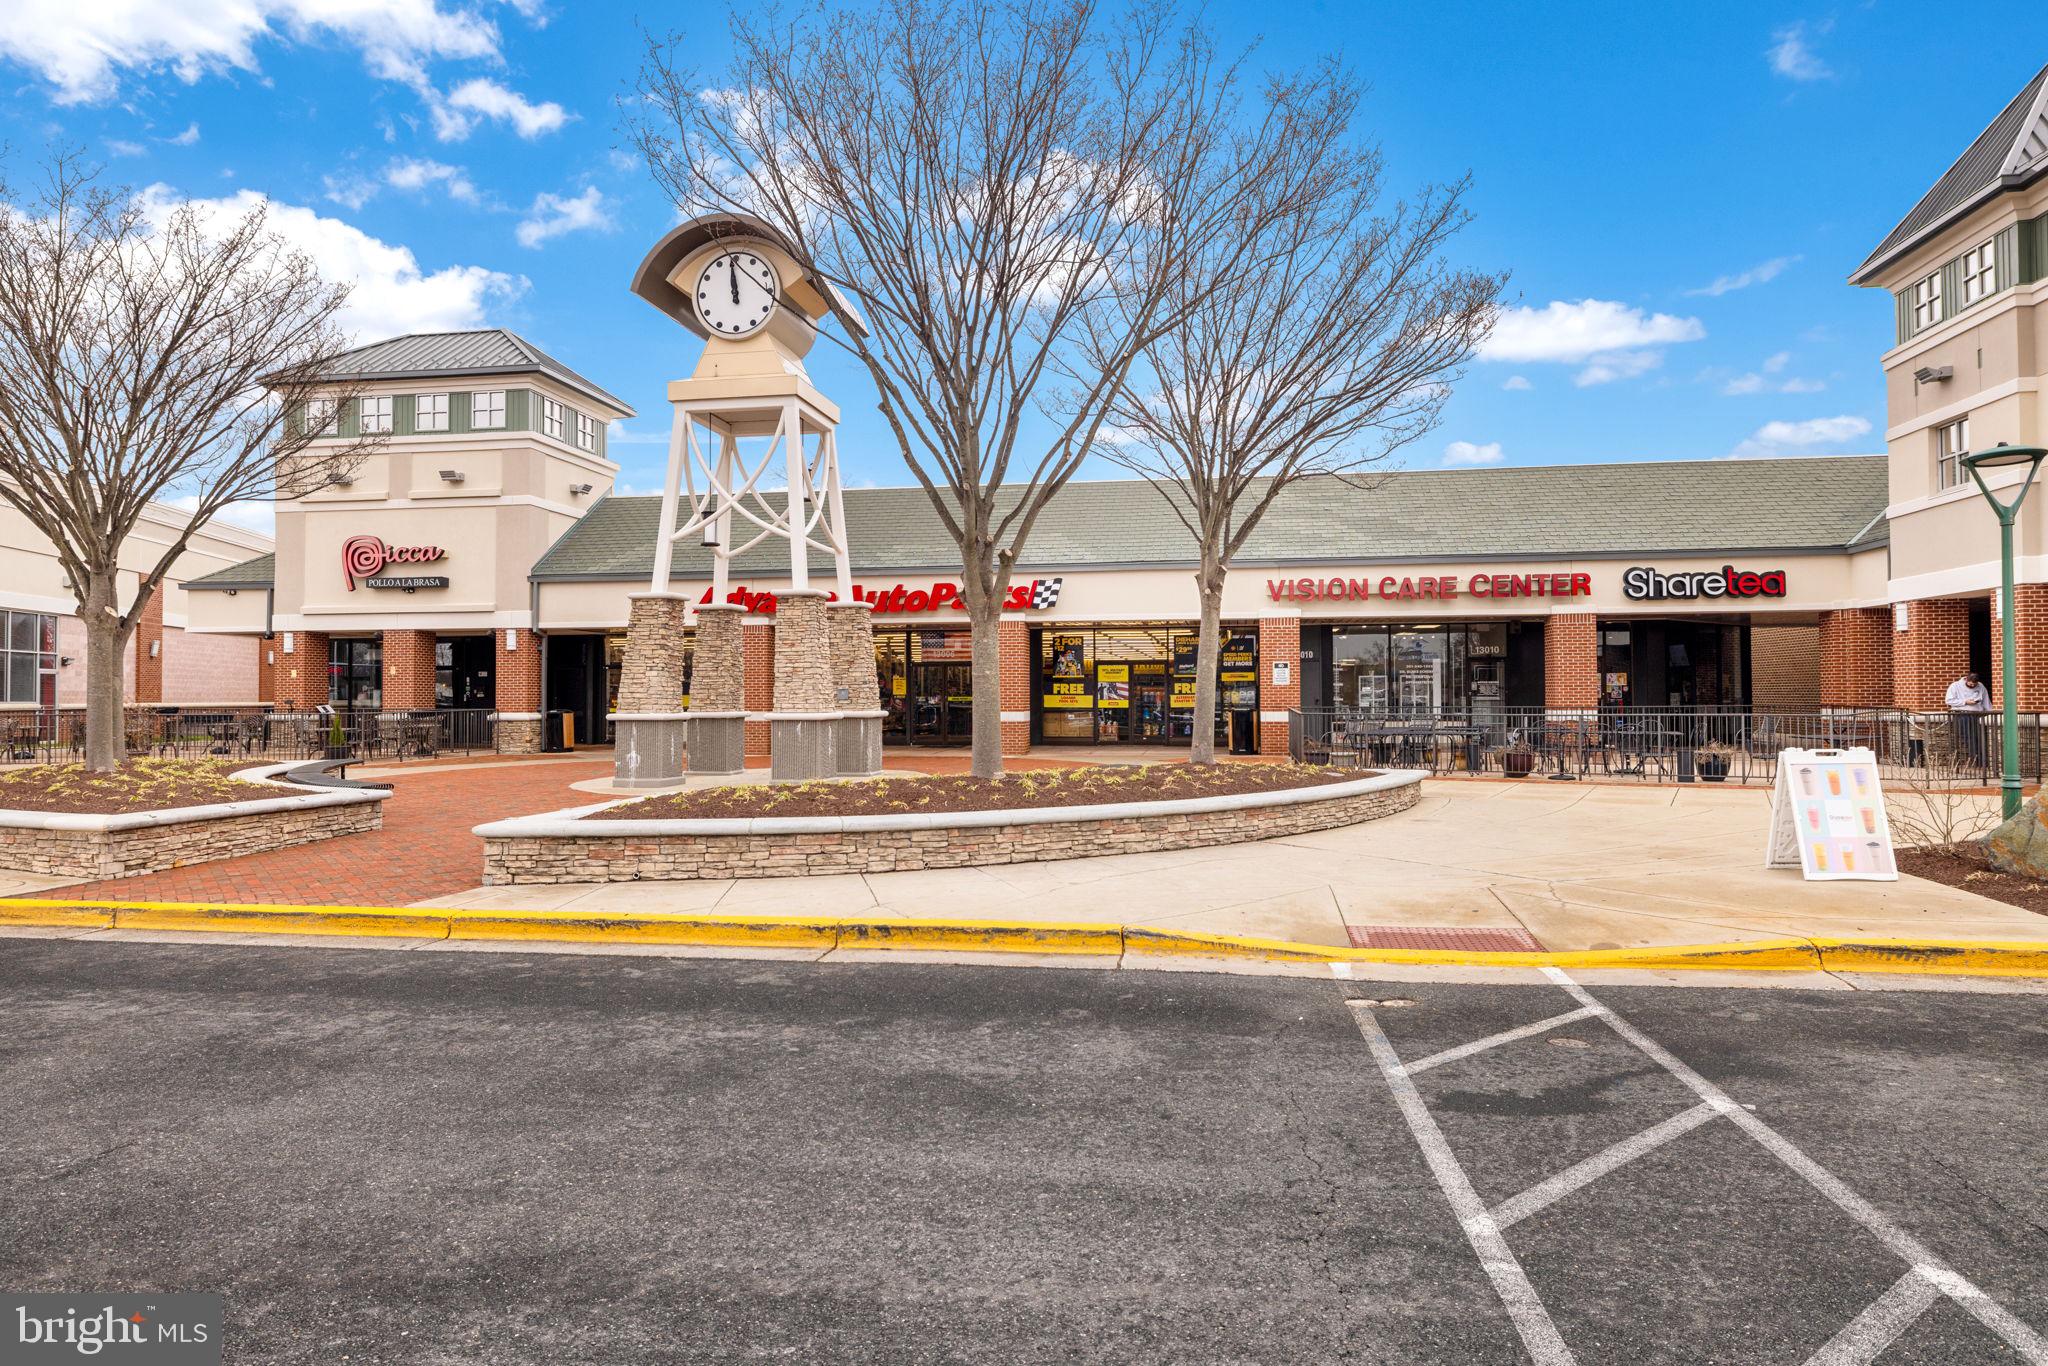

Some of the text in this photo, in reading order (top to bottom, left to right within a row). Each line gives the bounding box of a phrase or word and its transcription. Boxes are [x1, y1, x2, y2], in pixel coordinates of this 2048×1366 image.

[368, 578, 440, 587] POLLO A LA BRASA
[1267, 573, 1591, 602] VISION CARE CENTER
[1627, 567, 1786, 598] Sharetea
[1054, 638, 1082, 646] 2 FOR
[1475, 646, 1500, 654] 13010
[1053, 683, 1084, 694] FREE
